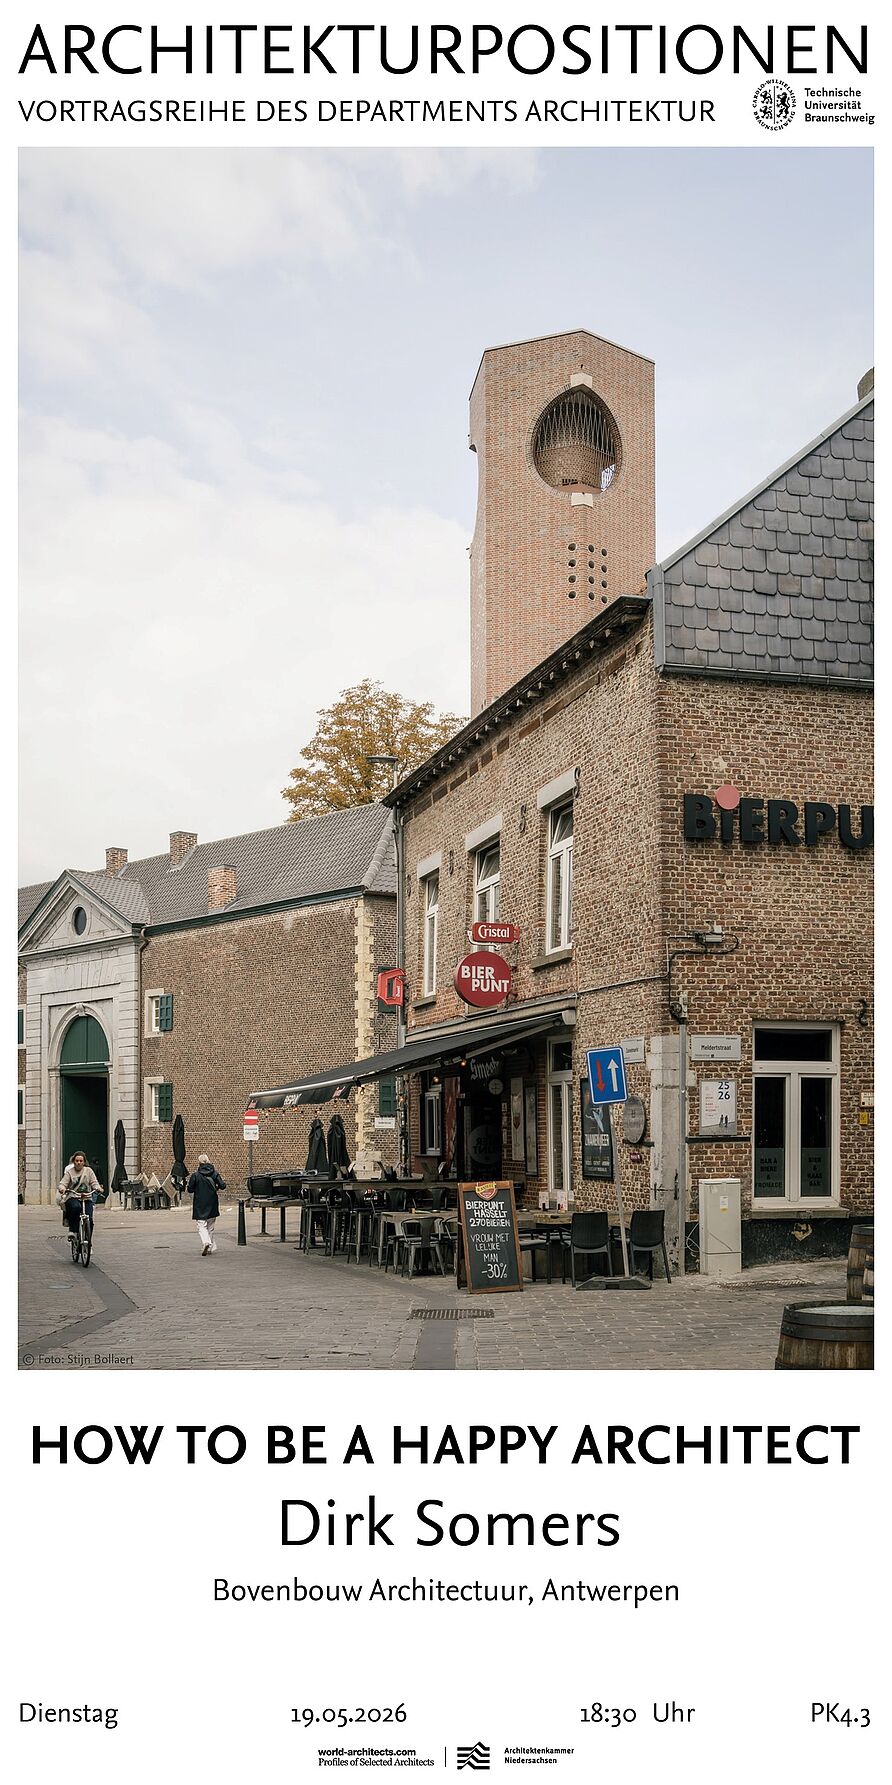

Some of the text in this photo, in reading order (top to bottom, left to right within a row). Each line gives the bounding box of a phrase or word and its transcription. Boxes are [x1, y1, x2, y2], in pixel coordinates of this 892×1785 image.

[478, 925, 509, 938] Cristal
[461, 965, 495, 979] BIER
[472, 979, 509, 992] PUNT
[718, 1081, 730, 1090] 25
[718, 1091, 731, 1100] 26
[465, 1201, 504, 1210] BIERPUNT
[473, 1209, 507, 1218] HASSELT
[486, 1219, 510, 1227] BIEREN
[471, 1233, 510, 1242] VROUW MET
[483, 1253, 499, 1263] MAN
[481, 1263, 507, 1279] -30%
